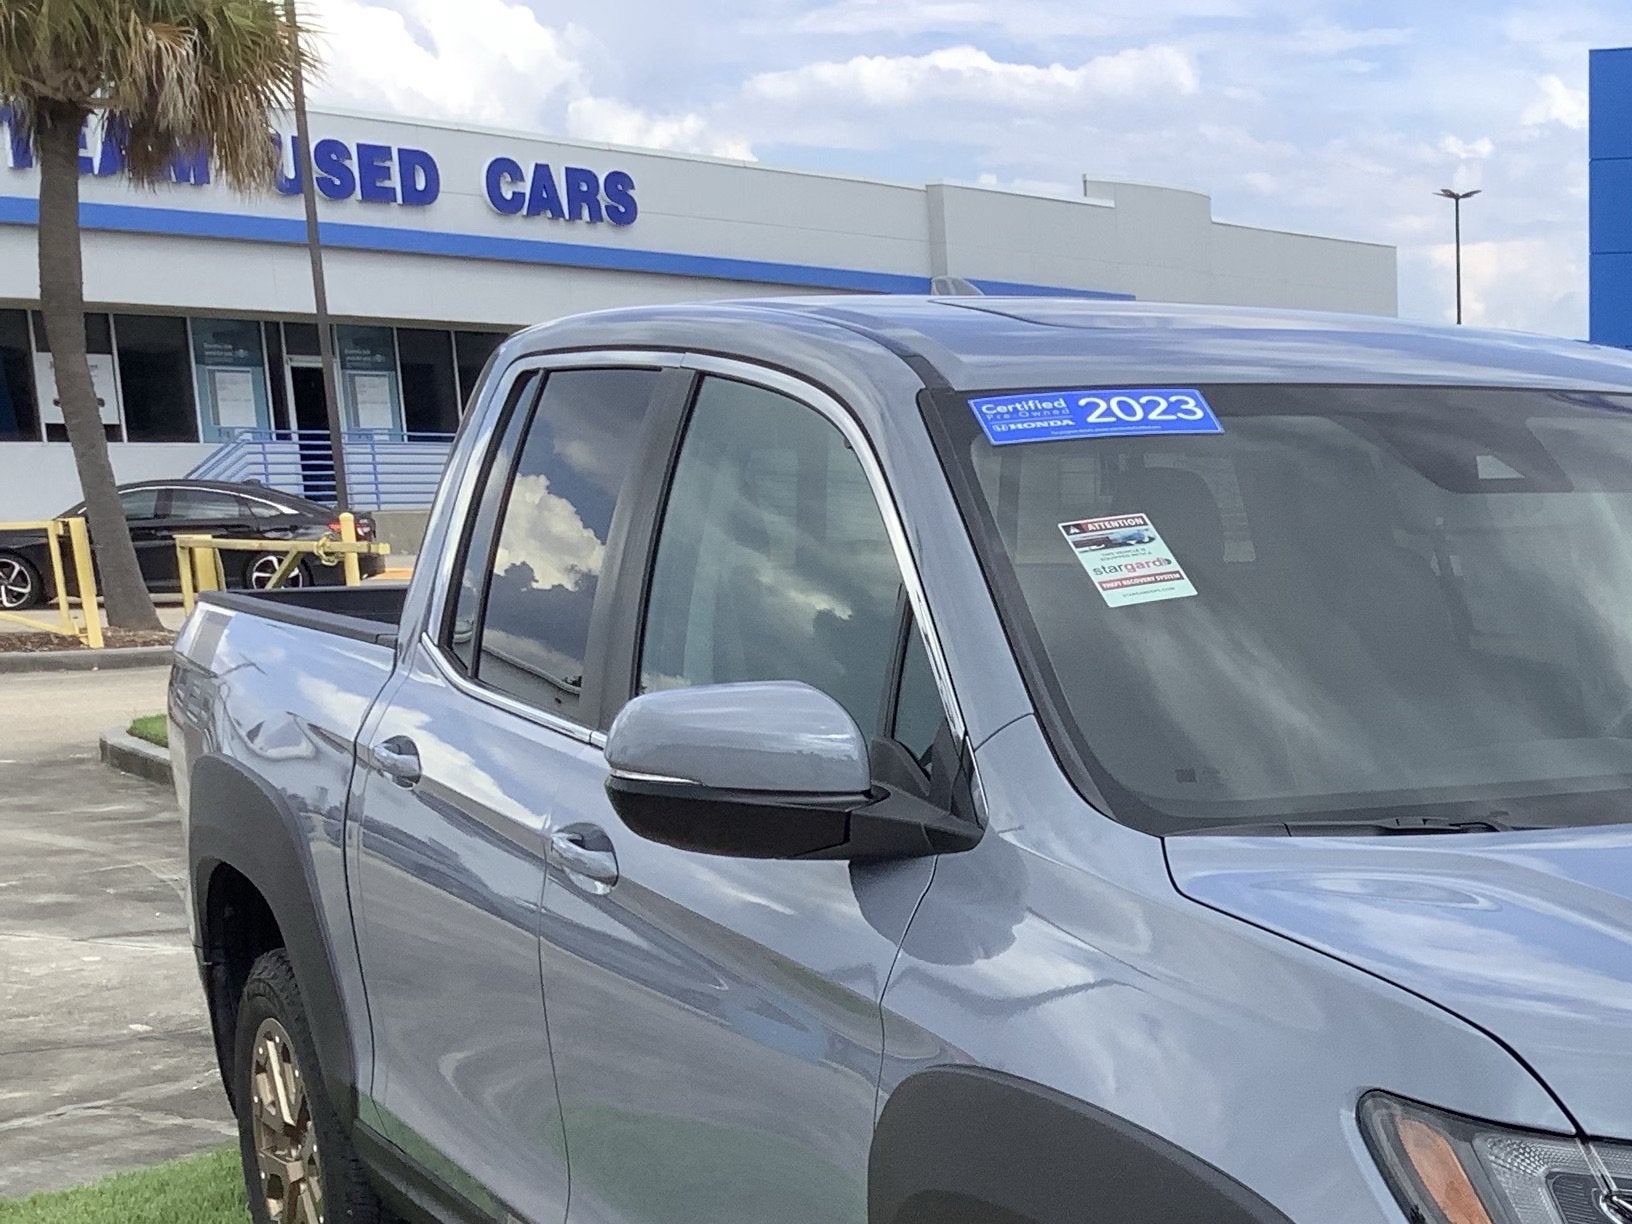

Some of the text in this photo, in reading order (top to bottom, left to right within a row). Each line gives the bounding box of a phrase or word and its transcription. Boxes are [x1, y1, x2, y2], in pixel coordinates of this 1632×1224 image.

[271, 131, 441, 206] USED
[485, 156, 639, 226] CARS
[981, 398, 1067, 415] Certified
[1078, 395, 1205, 423] 2023
[1010, 419, 1076, 430] HONDA
[1087, 517, 1144, 532] ATTENTION
[1092, 556, 1163, 577] stargard
